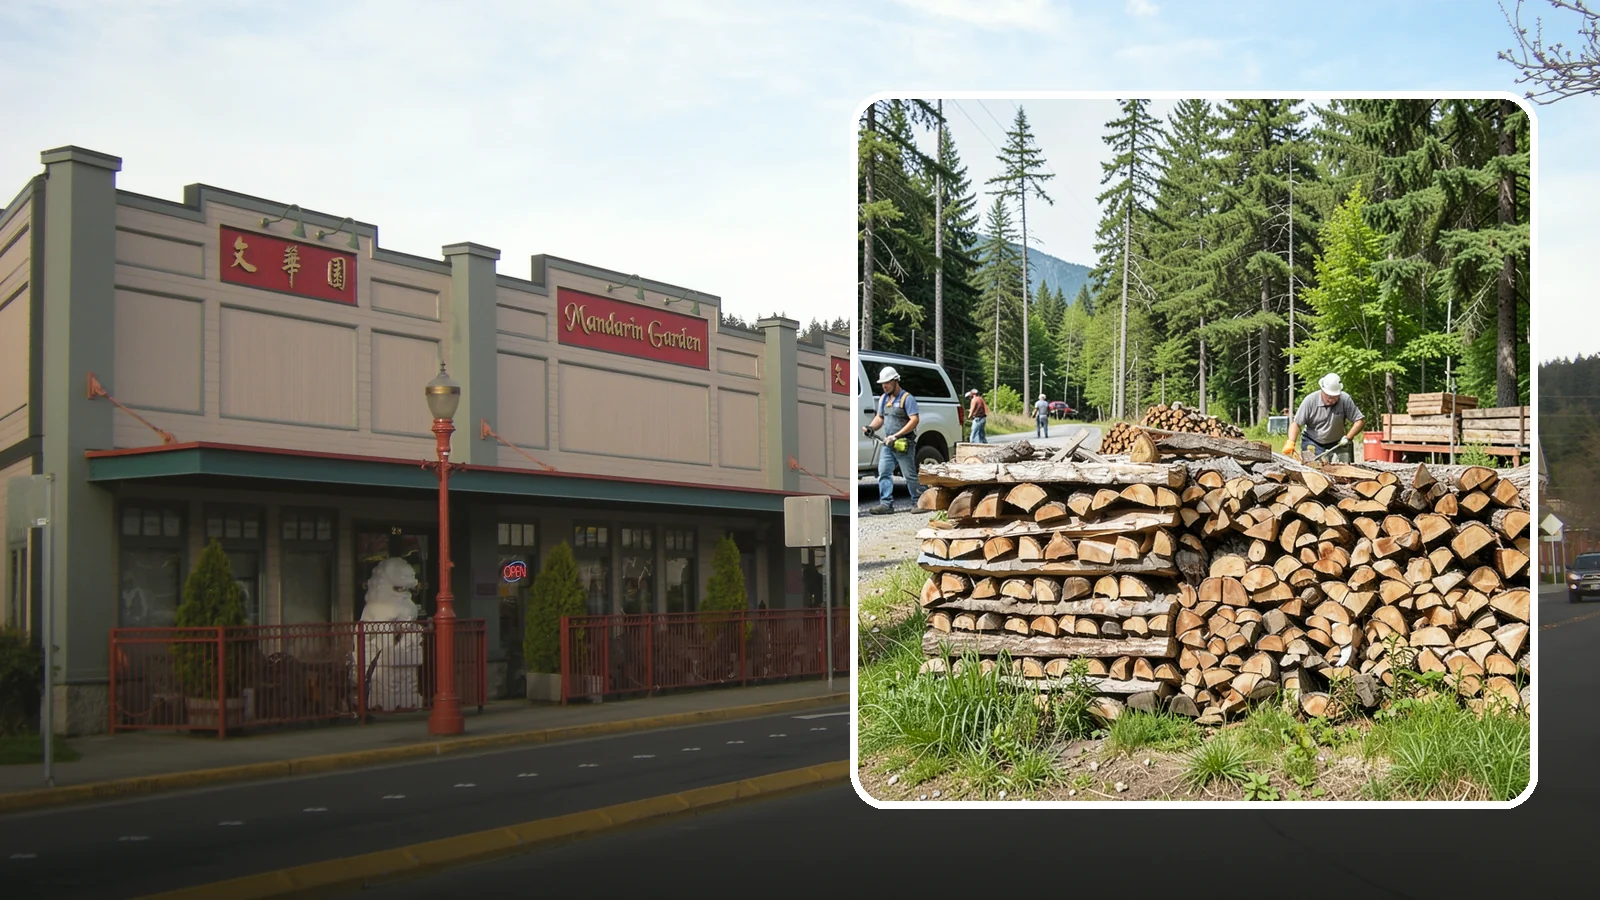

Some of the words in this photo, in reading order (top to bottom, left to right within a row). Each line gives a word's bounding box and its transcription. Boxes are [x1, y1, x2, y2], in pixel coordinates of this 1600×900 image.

[231, 236, 346, 291] 文華園
[565, 302, 644, 341] Mandarin
[648, 320, 701, 352] Garden
[503, 565, 527, 578] OPEN
